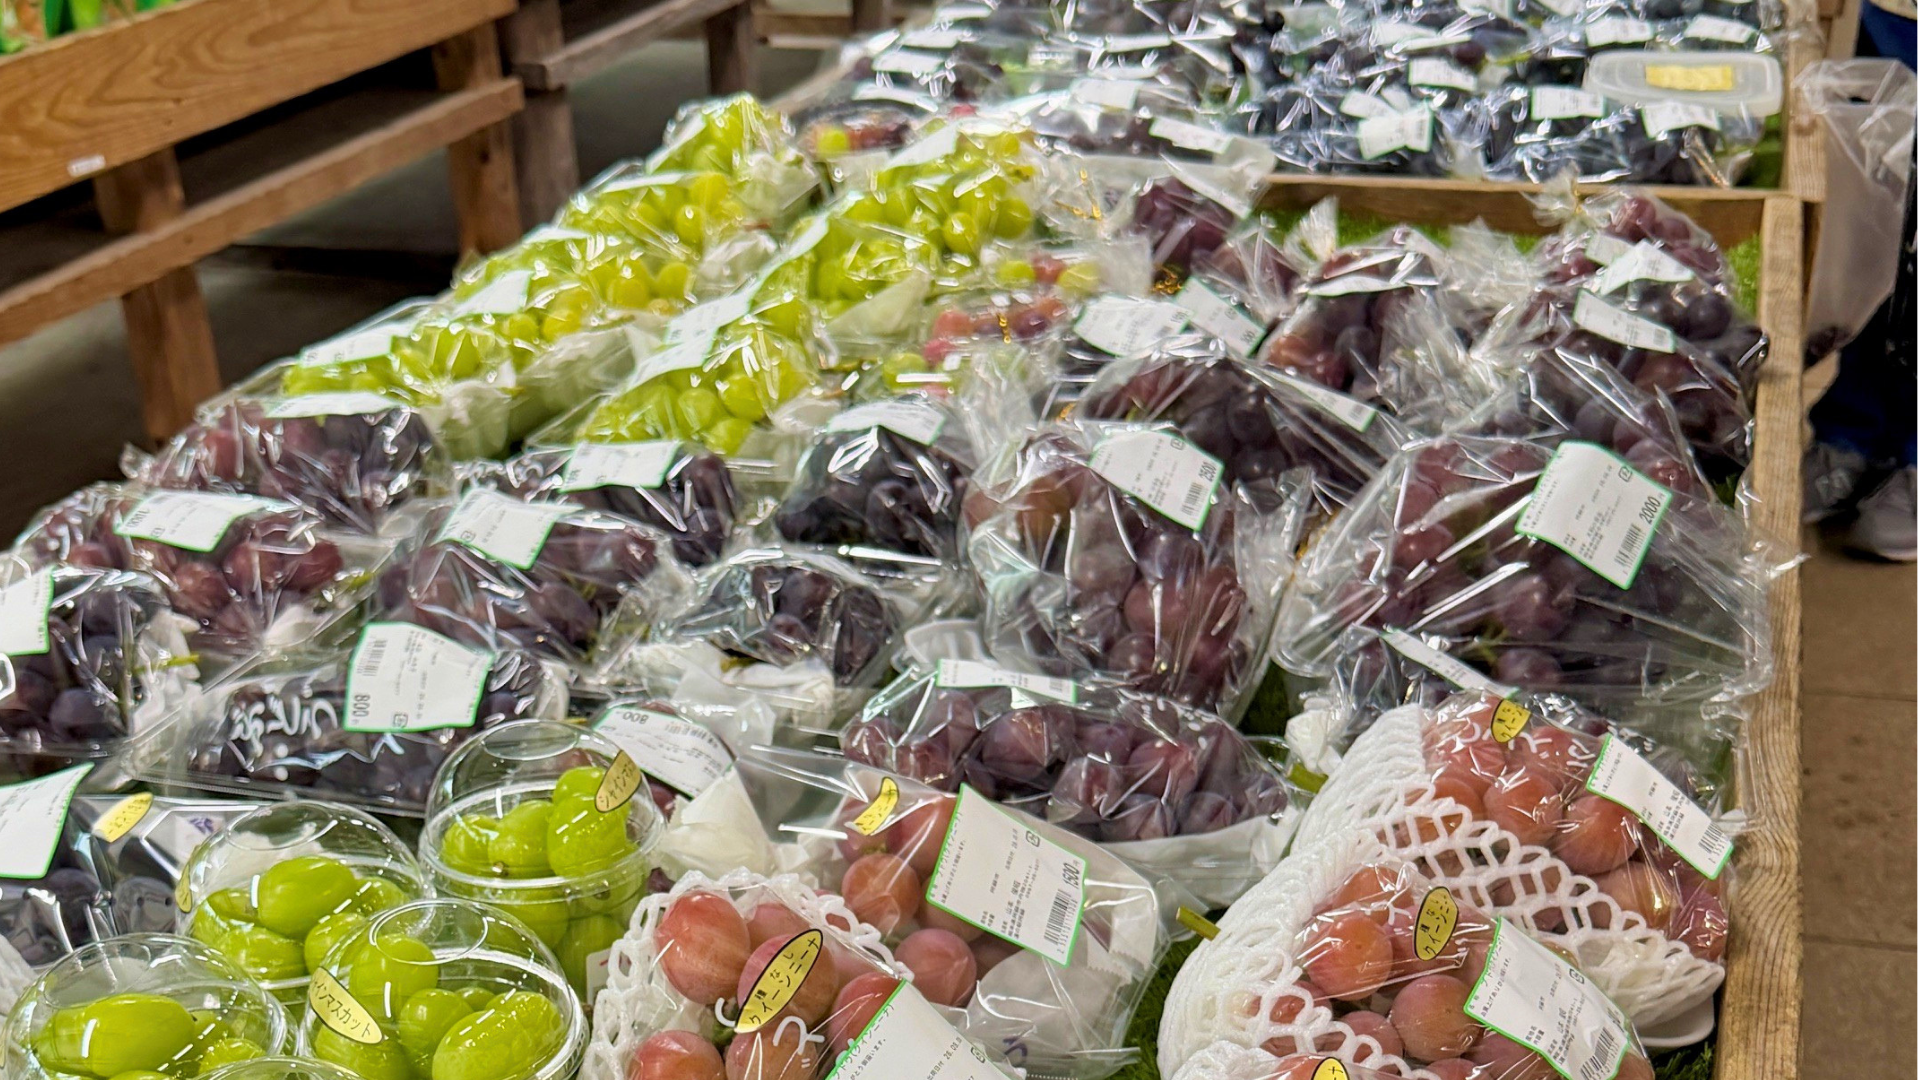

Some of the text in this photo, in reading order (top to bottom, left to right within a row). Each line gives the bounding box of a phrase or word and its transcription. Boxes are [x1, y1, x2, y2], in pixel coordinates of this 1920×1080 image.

[1199, 461, 1216, 481] 2500
[1639, 495, 1660, 523] 2000
[352, 694, 371, 717] 800
[622, 711, 649, 724] 800
[1062, 862, 1079, 888] 1500
[748, 938, 819, 1024] クイーンニーナ
